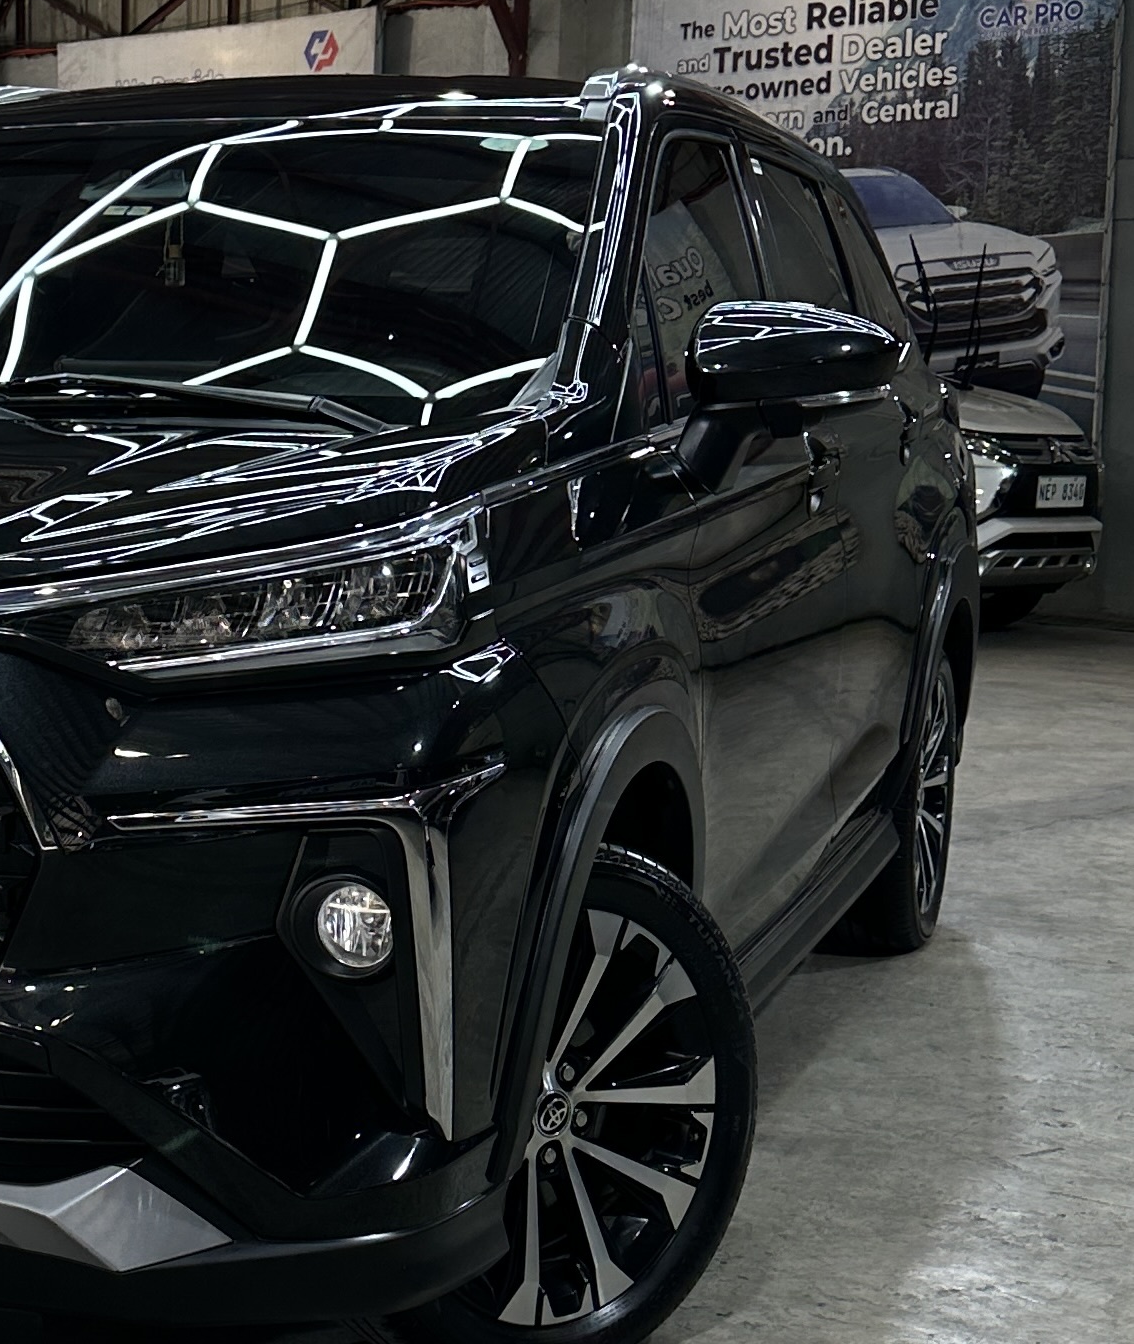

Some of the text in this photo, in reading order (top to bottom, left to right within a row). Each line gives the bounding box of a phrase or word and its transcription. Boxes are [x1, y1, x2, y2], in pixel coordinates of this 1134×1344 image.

[681, 21, 715, 40] The
[722, 7, 797, 41] Most
[979, 0, 1084, 29] CAR PRO
[677, 28, 948, 74] and Trusted Dealer
[839, 63, 958, 96] Vehicles
[813, 105, 849, 124] and
[861, 94, 959, 125] Central
